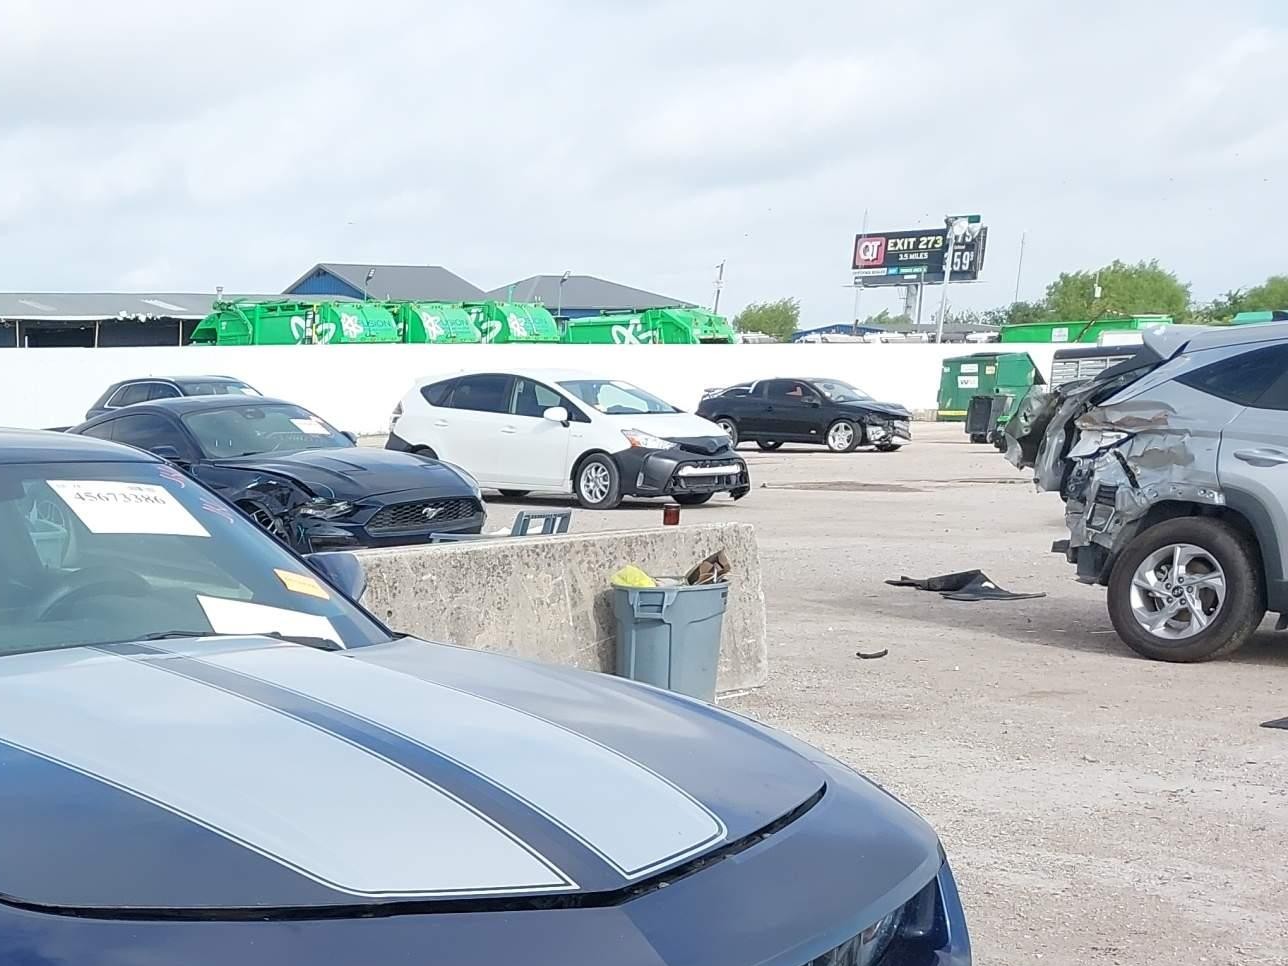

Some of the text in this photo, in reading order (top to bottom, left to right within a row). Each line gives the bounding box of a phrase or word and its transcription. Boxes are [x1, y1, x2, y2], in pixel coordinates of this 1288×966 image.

[887, 238, 916, 251] EXIT
[918, 235, 943, 249] 273
[859, 240, 880, 262] QT
[909, 252, 929, 260] MILES
[73, 490, 167, 505] 45673386
